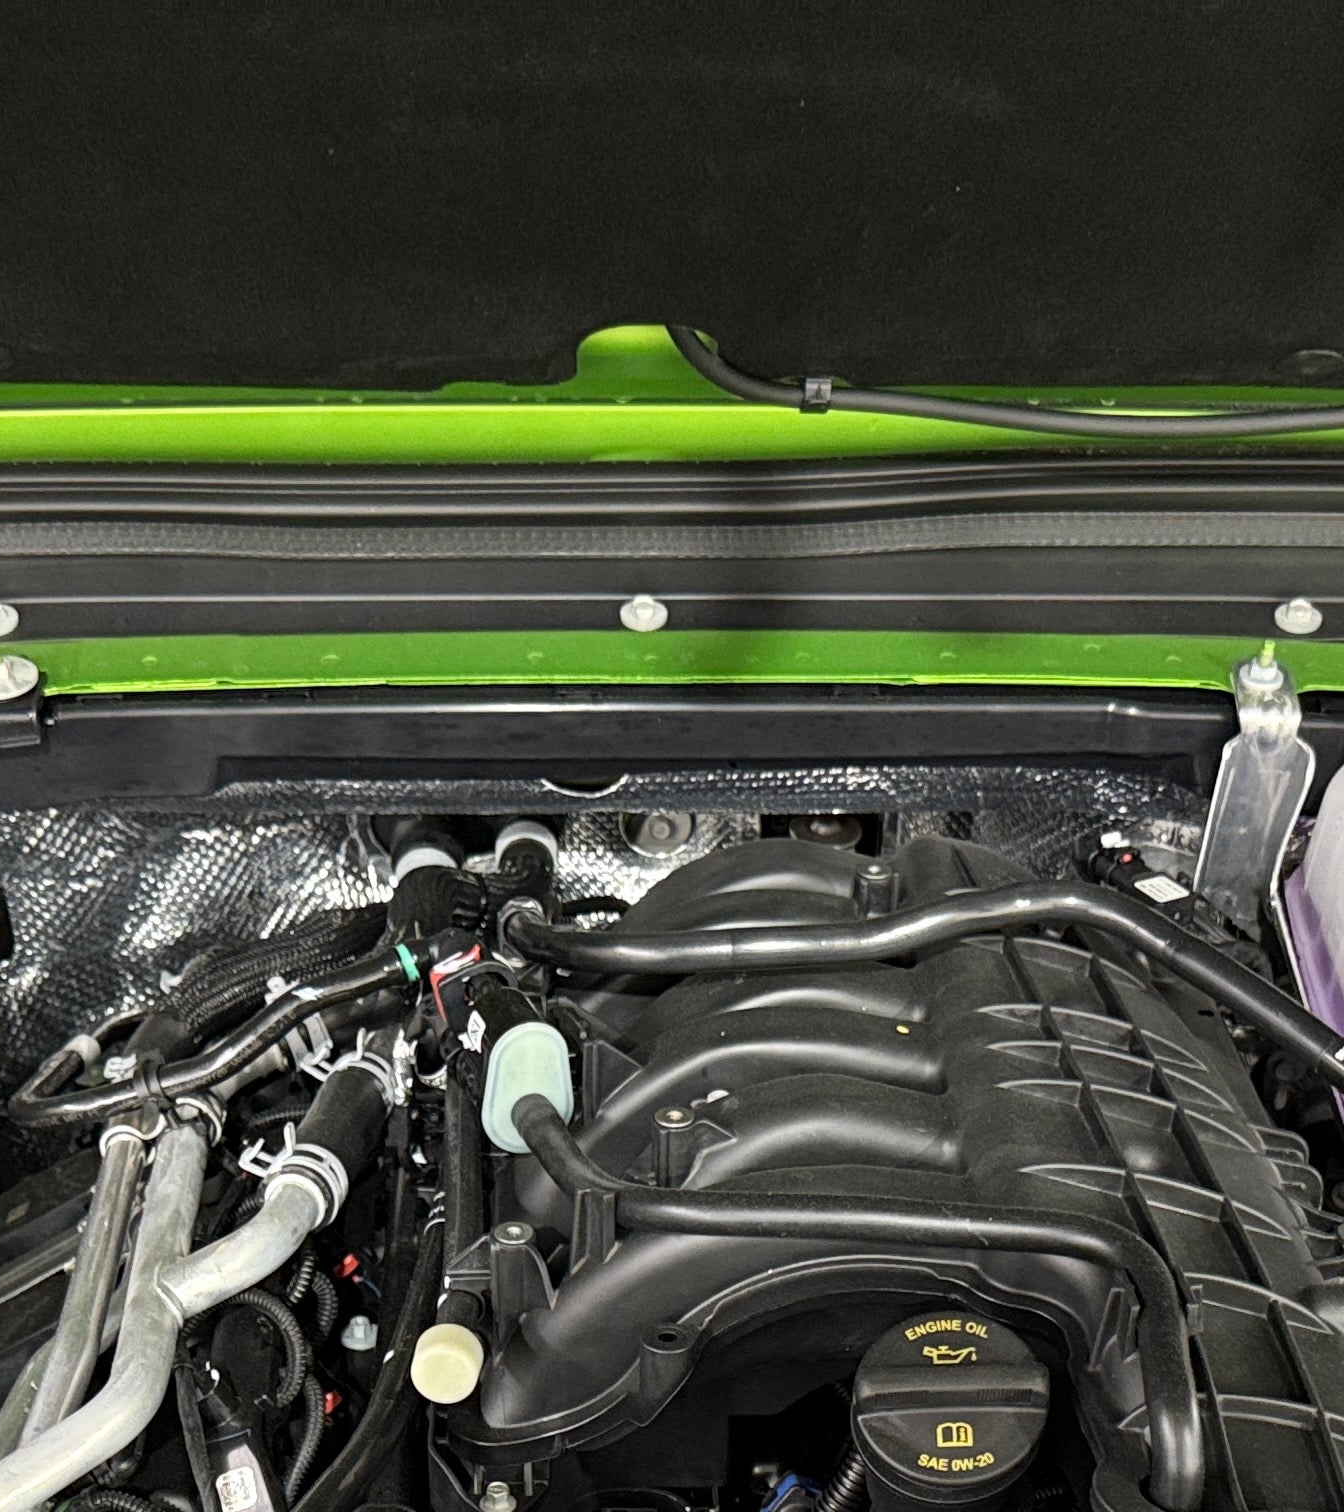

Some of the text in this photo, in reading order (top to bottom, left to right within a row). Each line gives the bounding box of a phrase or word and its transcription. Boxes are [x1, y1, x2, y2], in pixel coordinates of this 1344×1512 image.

[904, 1319, 989, 1342] ENGINE OIL
[917, 1452, 995, 1471] SAE 0W-20
